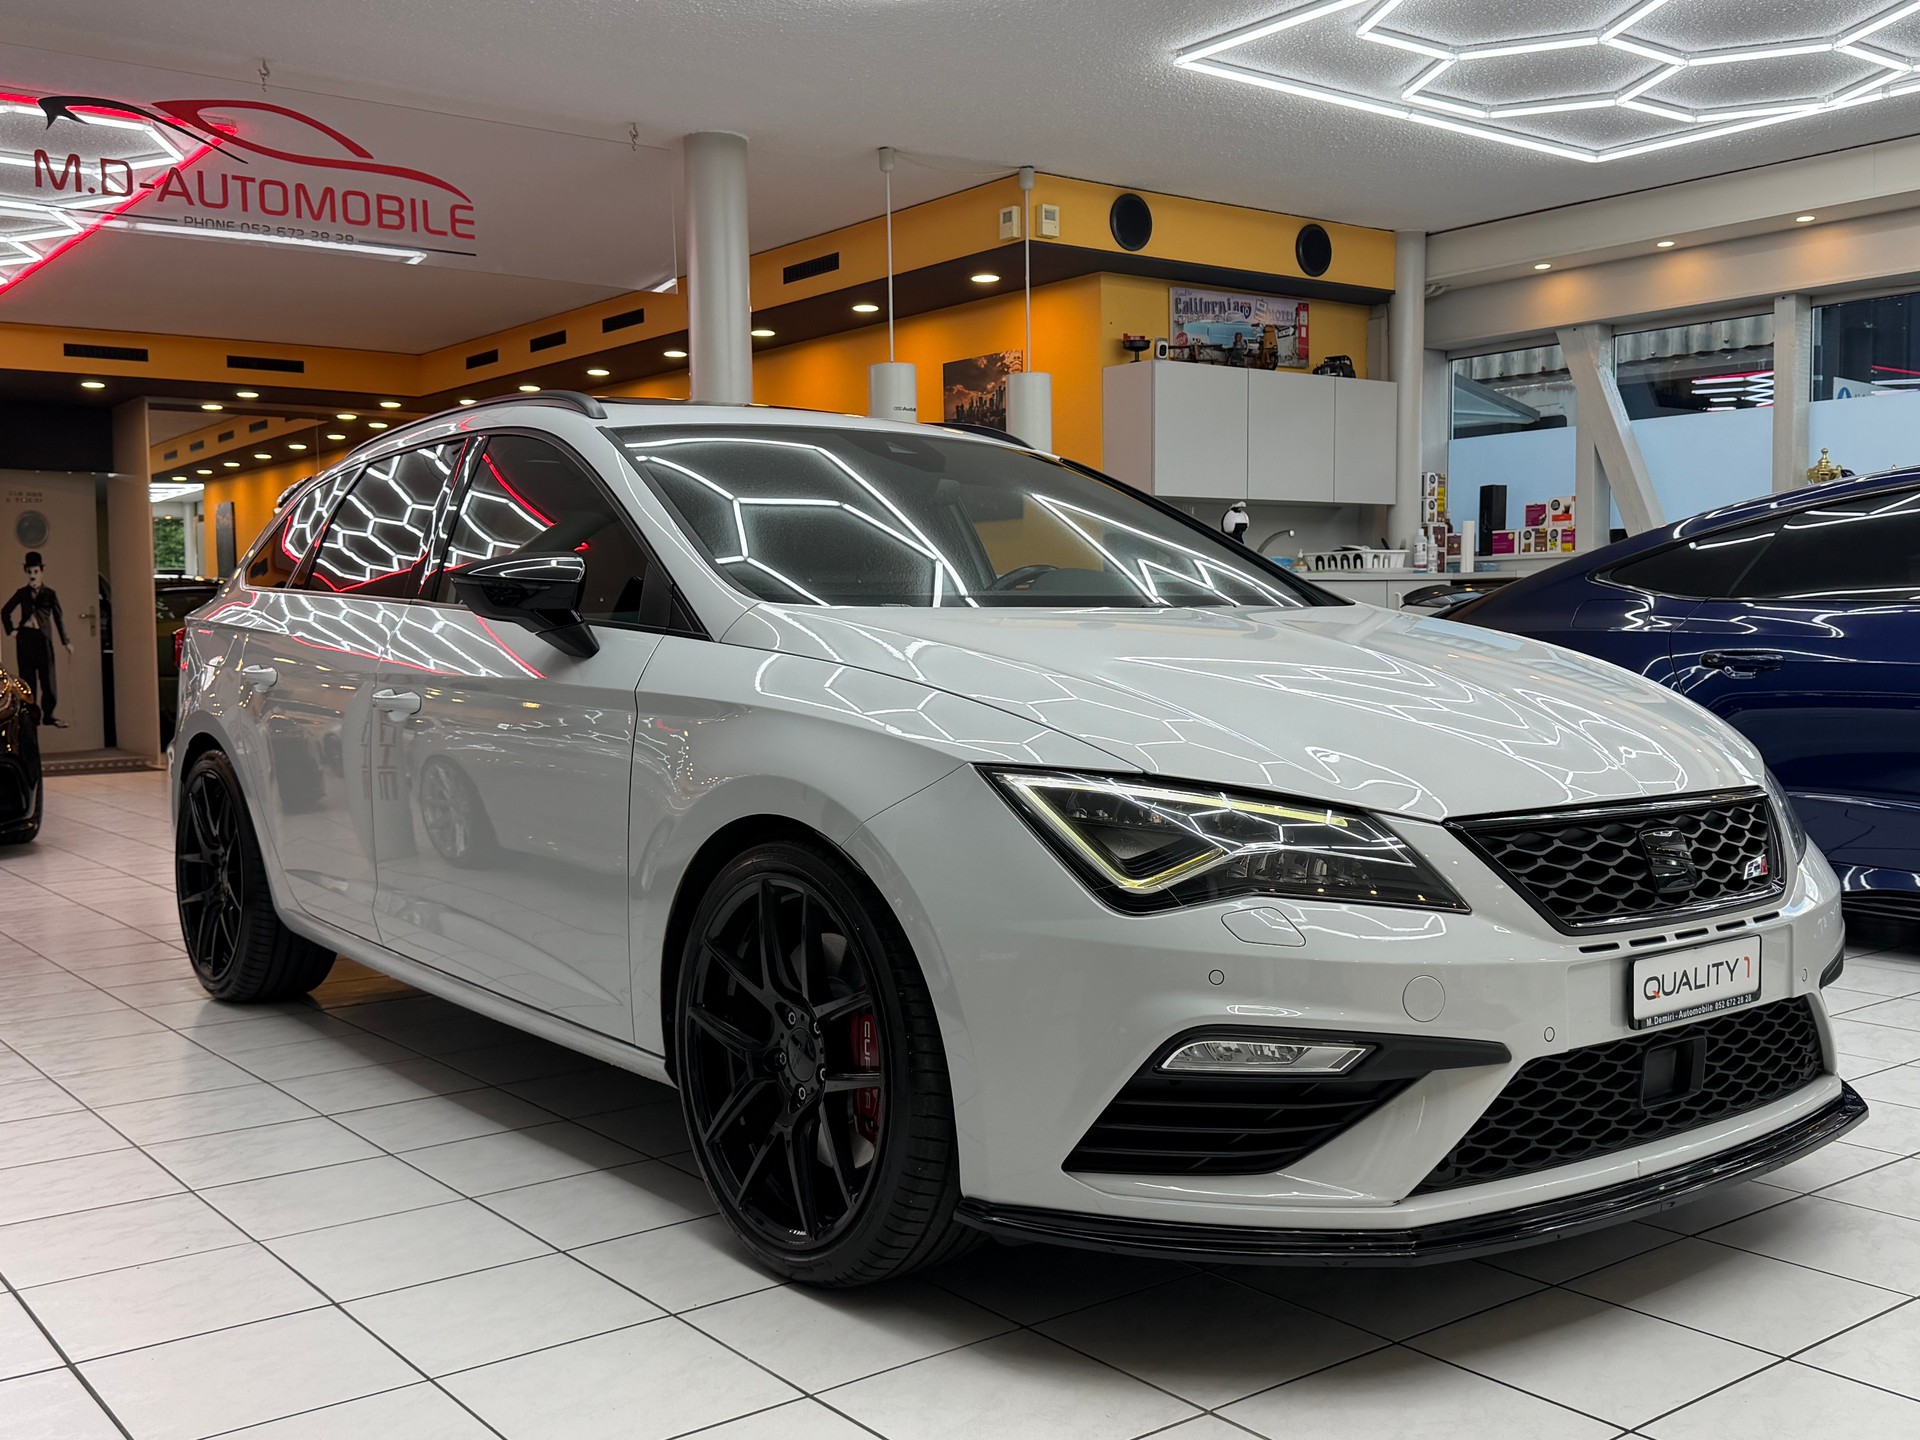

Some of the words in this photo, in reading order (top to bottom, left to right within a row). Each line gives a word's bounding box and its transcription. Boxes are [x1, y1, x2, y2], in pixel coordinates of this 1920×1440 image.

[34, 148, 476, 240] M.D-AUTOMOBILE
[184, 215, 235, 229] PHONE
[1175, 297, 1240, 315] California
[1643, 958, 1739, 1000] QUALITY
[1715, 1001, 1726, 1010] 052
[1726, 998, 1737, 1007] 672
[1737, 996, 1744, 1004] 28
[1745, 994, 1752, 1002] 28
